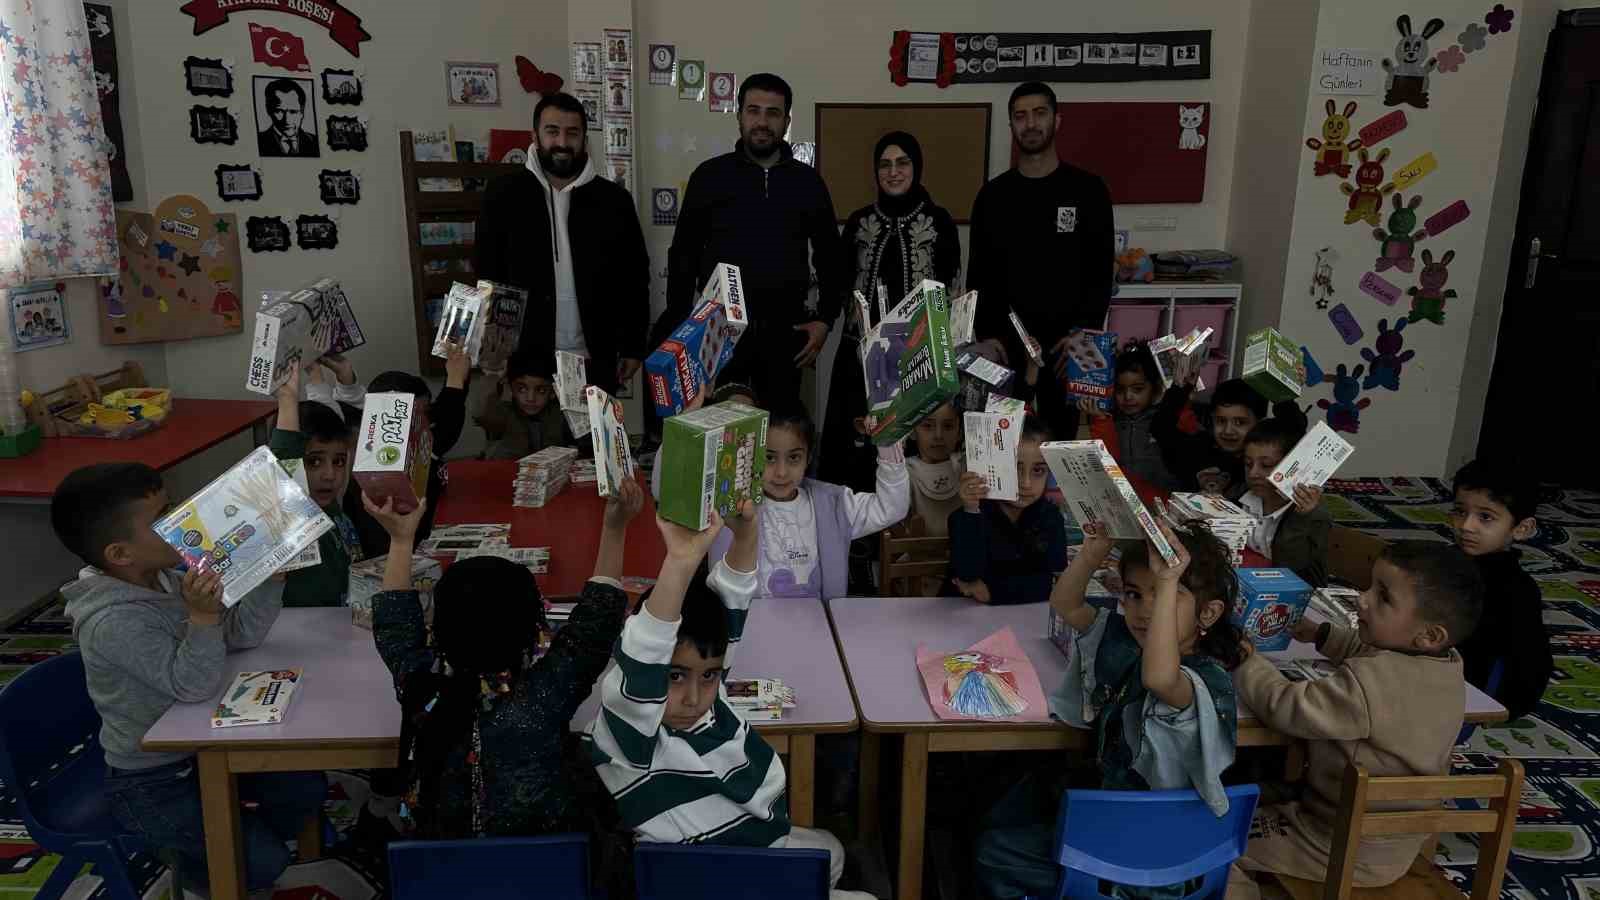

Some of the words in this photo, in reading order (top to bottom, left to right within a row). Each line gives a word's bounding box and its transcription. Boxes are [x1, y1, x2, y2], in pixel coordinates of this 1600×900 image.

[726, 266, 740, 305] ALTIGEN
[250, 356, 264, 387] CHESS
[381, 412, 404, 443] PAT
